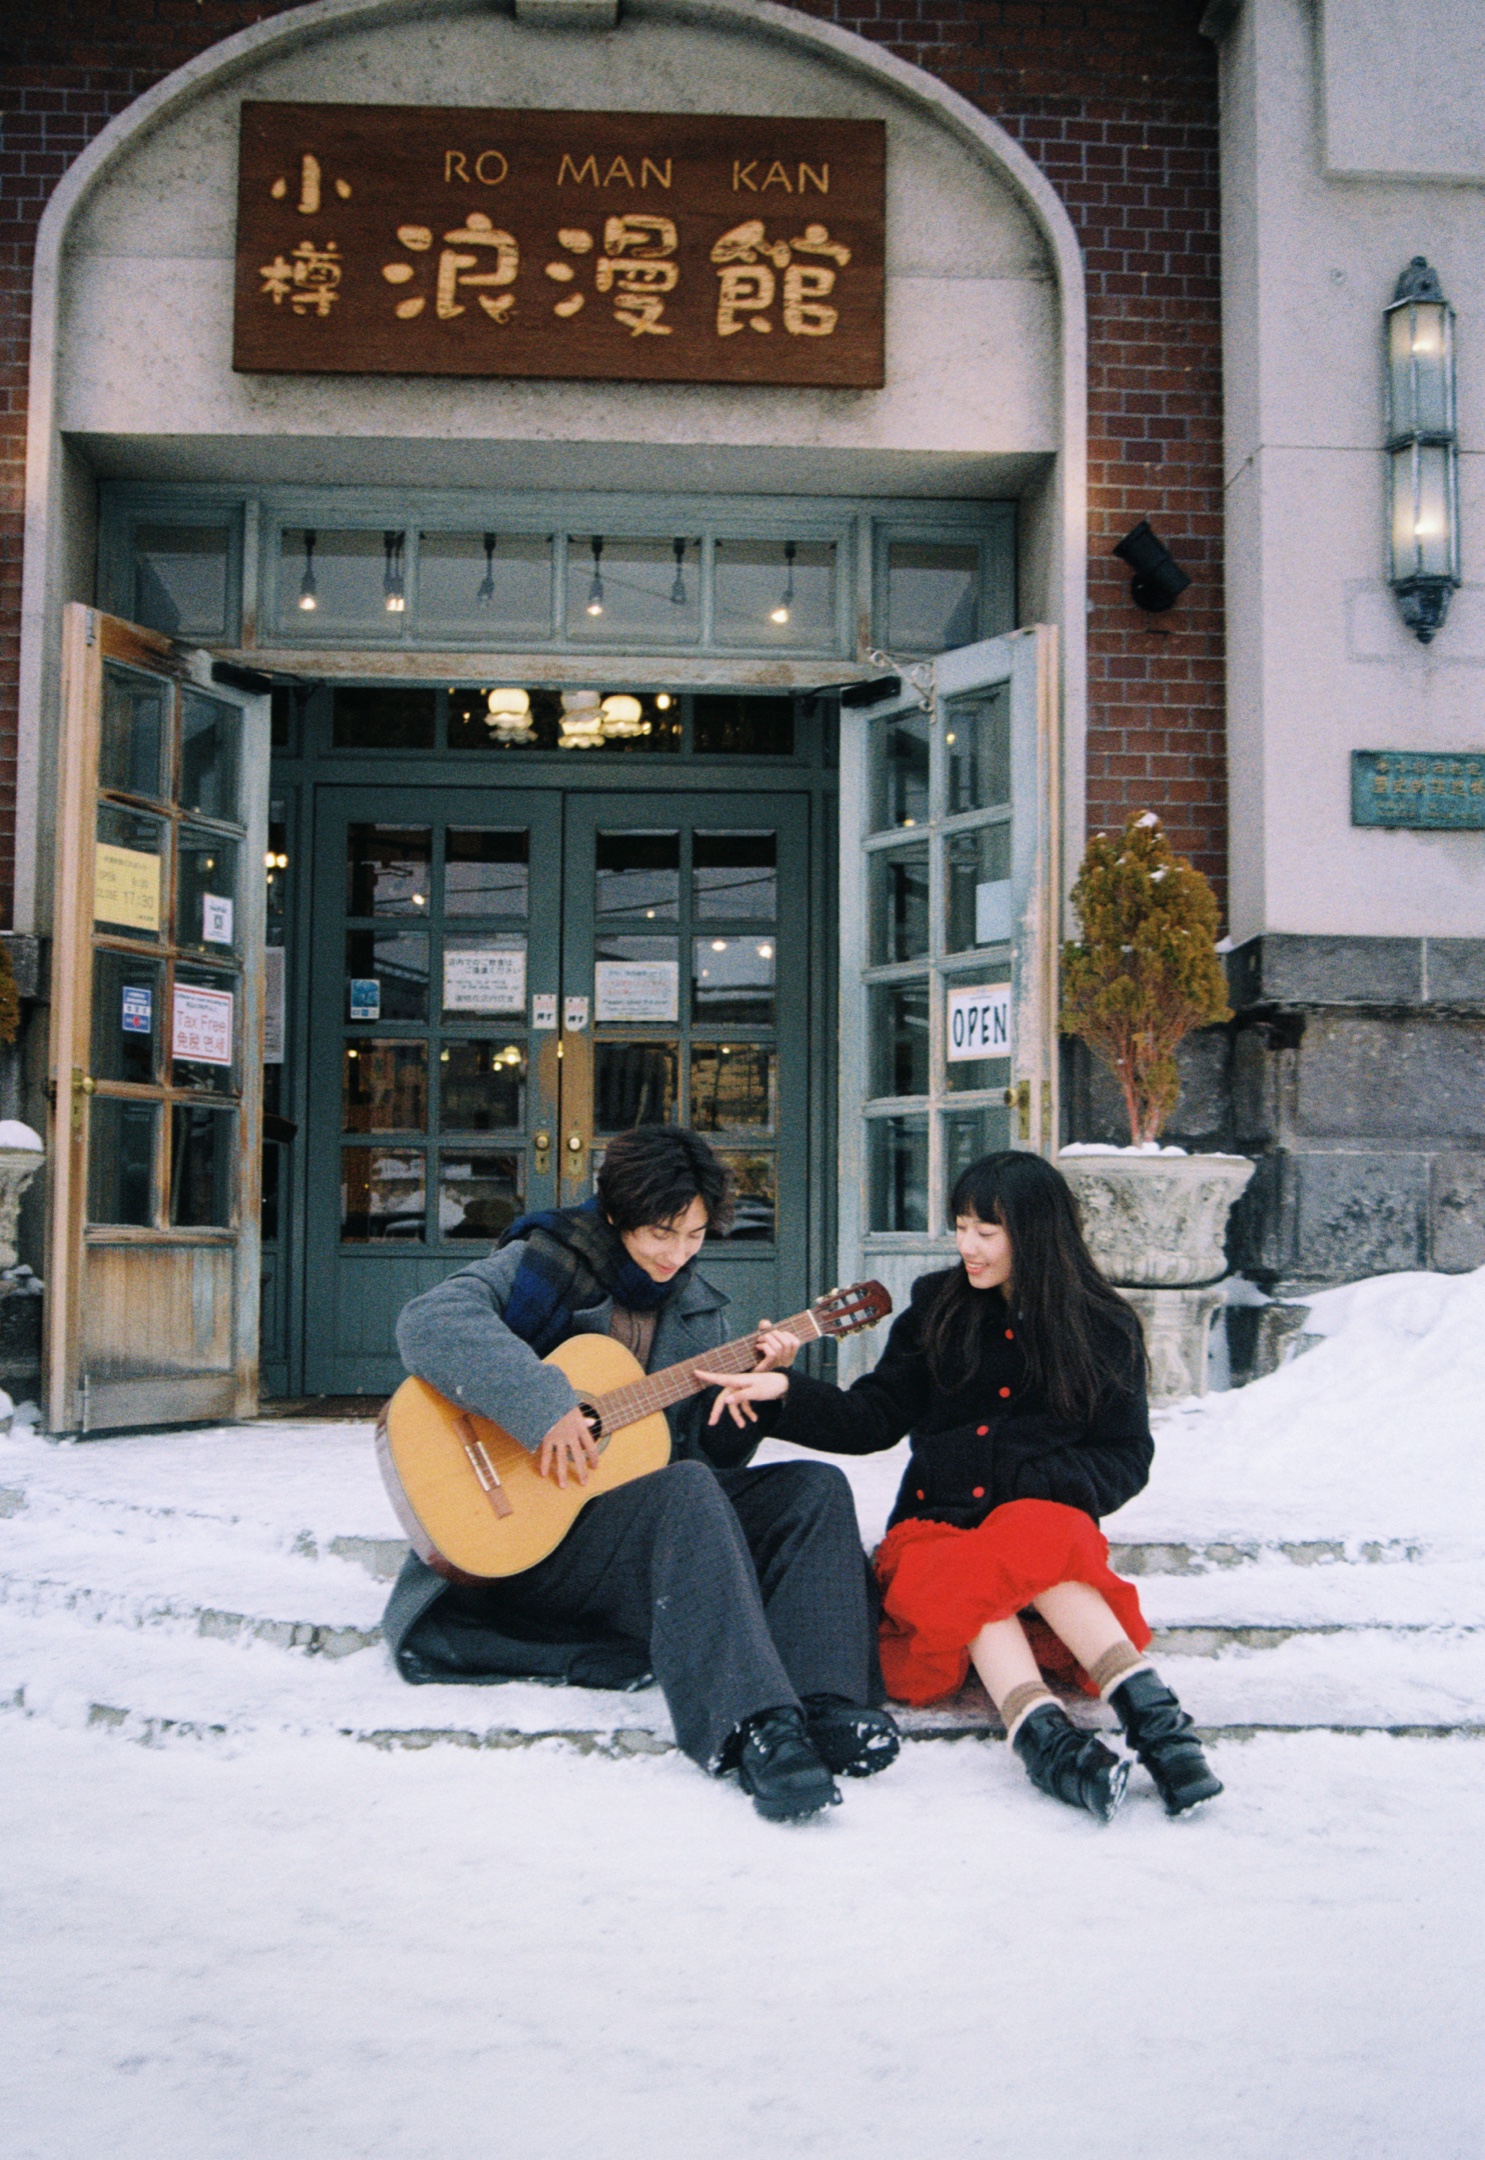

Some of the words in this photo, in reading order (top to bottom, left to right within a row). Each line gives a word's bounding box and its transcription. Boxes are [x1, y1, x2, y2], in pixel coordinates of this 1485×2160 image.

[444, 150, 509, 185] RO
[557, 153, 672, 190] MAN
[731, 160, 830, 195] KAN
[259, 154, 352, 318] 小樽
[382, 212, 852, 337] 浪漫館
[177, 1010, 198, 1030] Tax
[201, 1014, 226, 1034] Free
[953, 1003, 1007, 1047] OPEN
